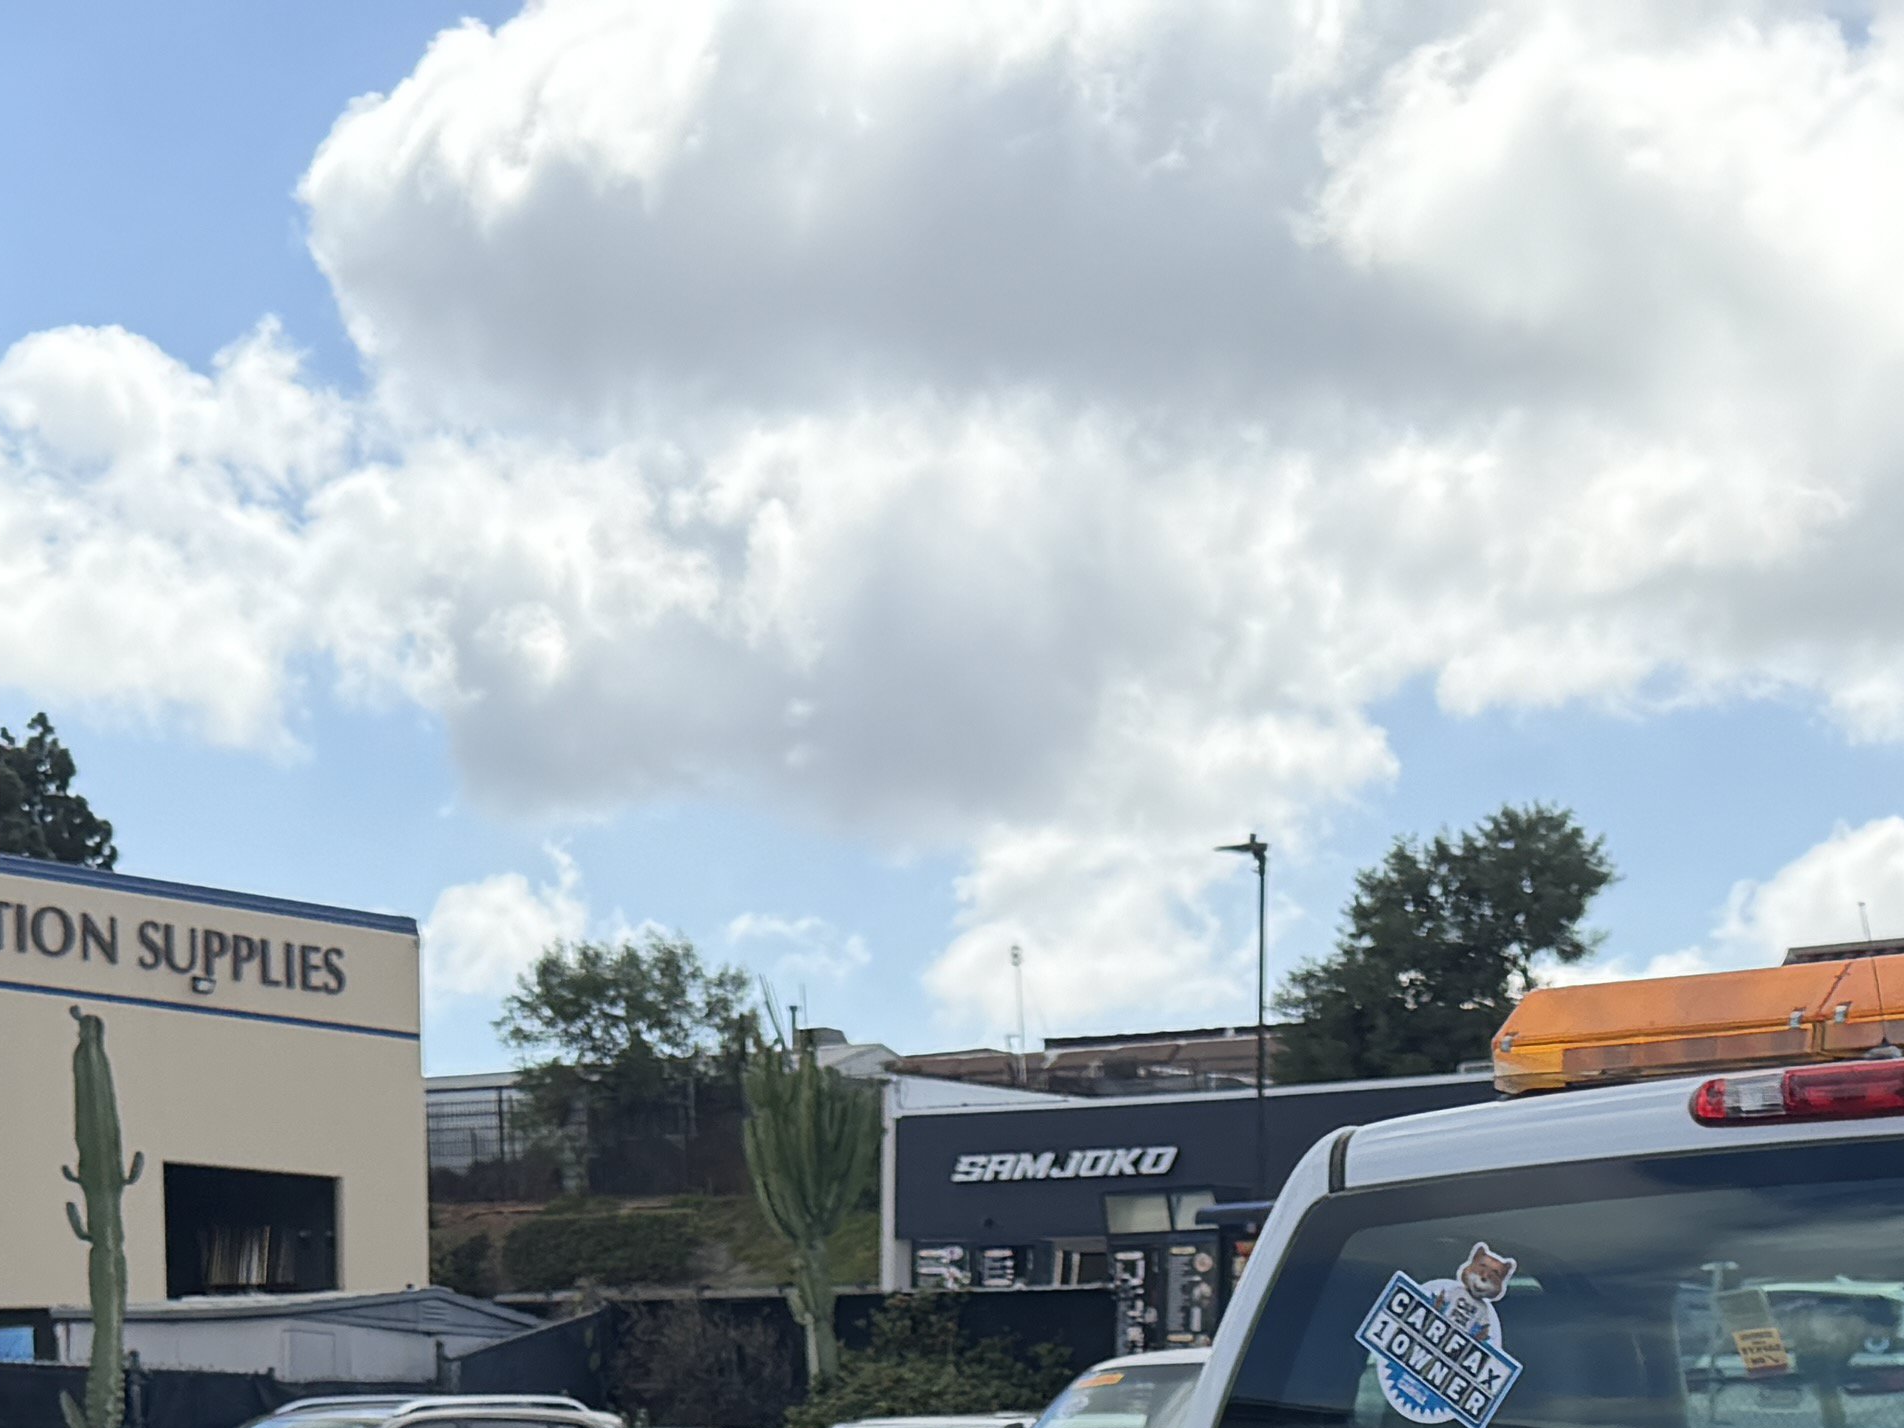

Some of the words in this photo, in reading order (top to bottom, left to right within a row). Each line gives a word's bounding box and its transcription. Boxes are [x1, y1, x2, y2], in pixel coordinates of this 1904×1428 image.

[137, 920, 347, 996] SUPPLIES
[951, 1146, 1180, 1183] SAMJOKO
[1389, 1291, 1501, 1393] CARFAX
[1391, 1333, 1487, 1416] OWNER
